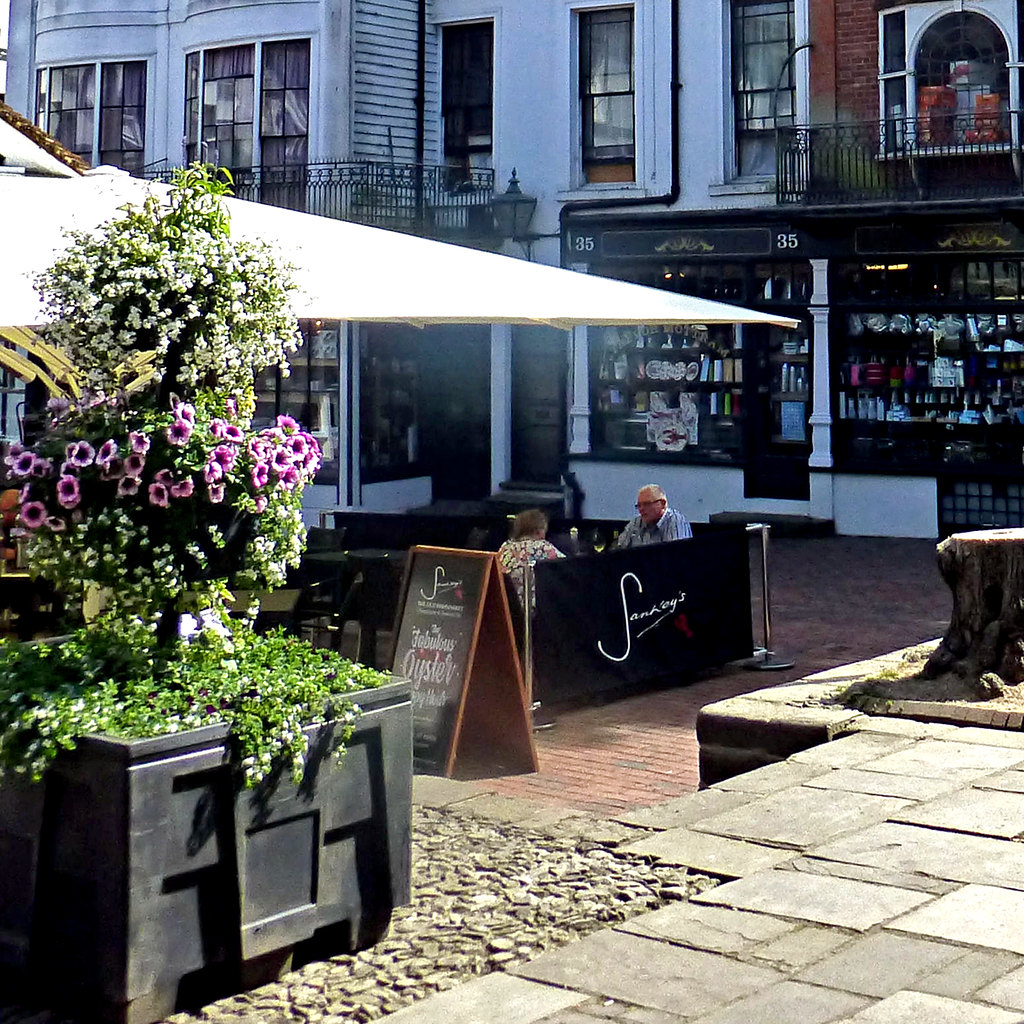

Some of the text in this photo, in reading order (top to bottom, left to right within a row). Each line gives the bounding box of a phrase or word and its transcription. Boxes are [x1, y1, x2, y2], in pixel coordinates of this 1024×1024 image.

[575, 236, 594, 251] 35
[777, 233, 798, 249] 35
[411, 628, 457, 652] Fabulous
[401, 648, 457, 690] Oyster
